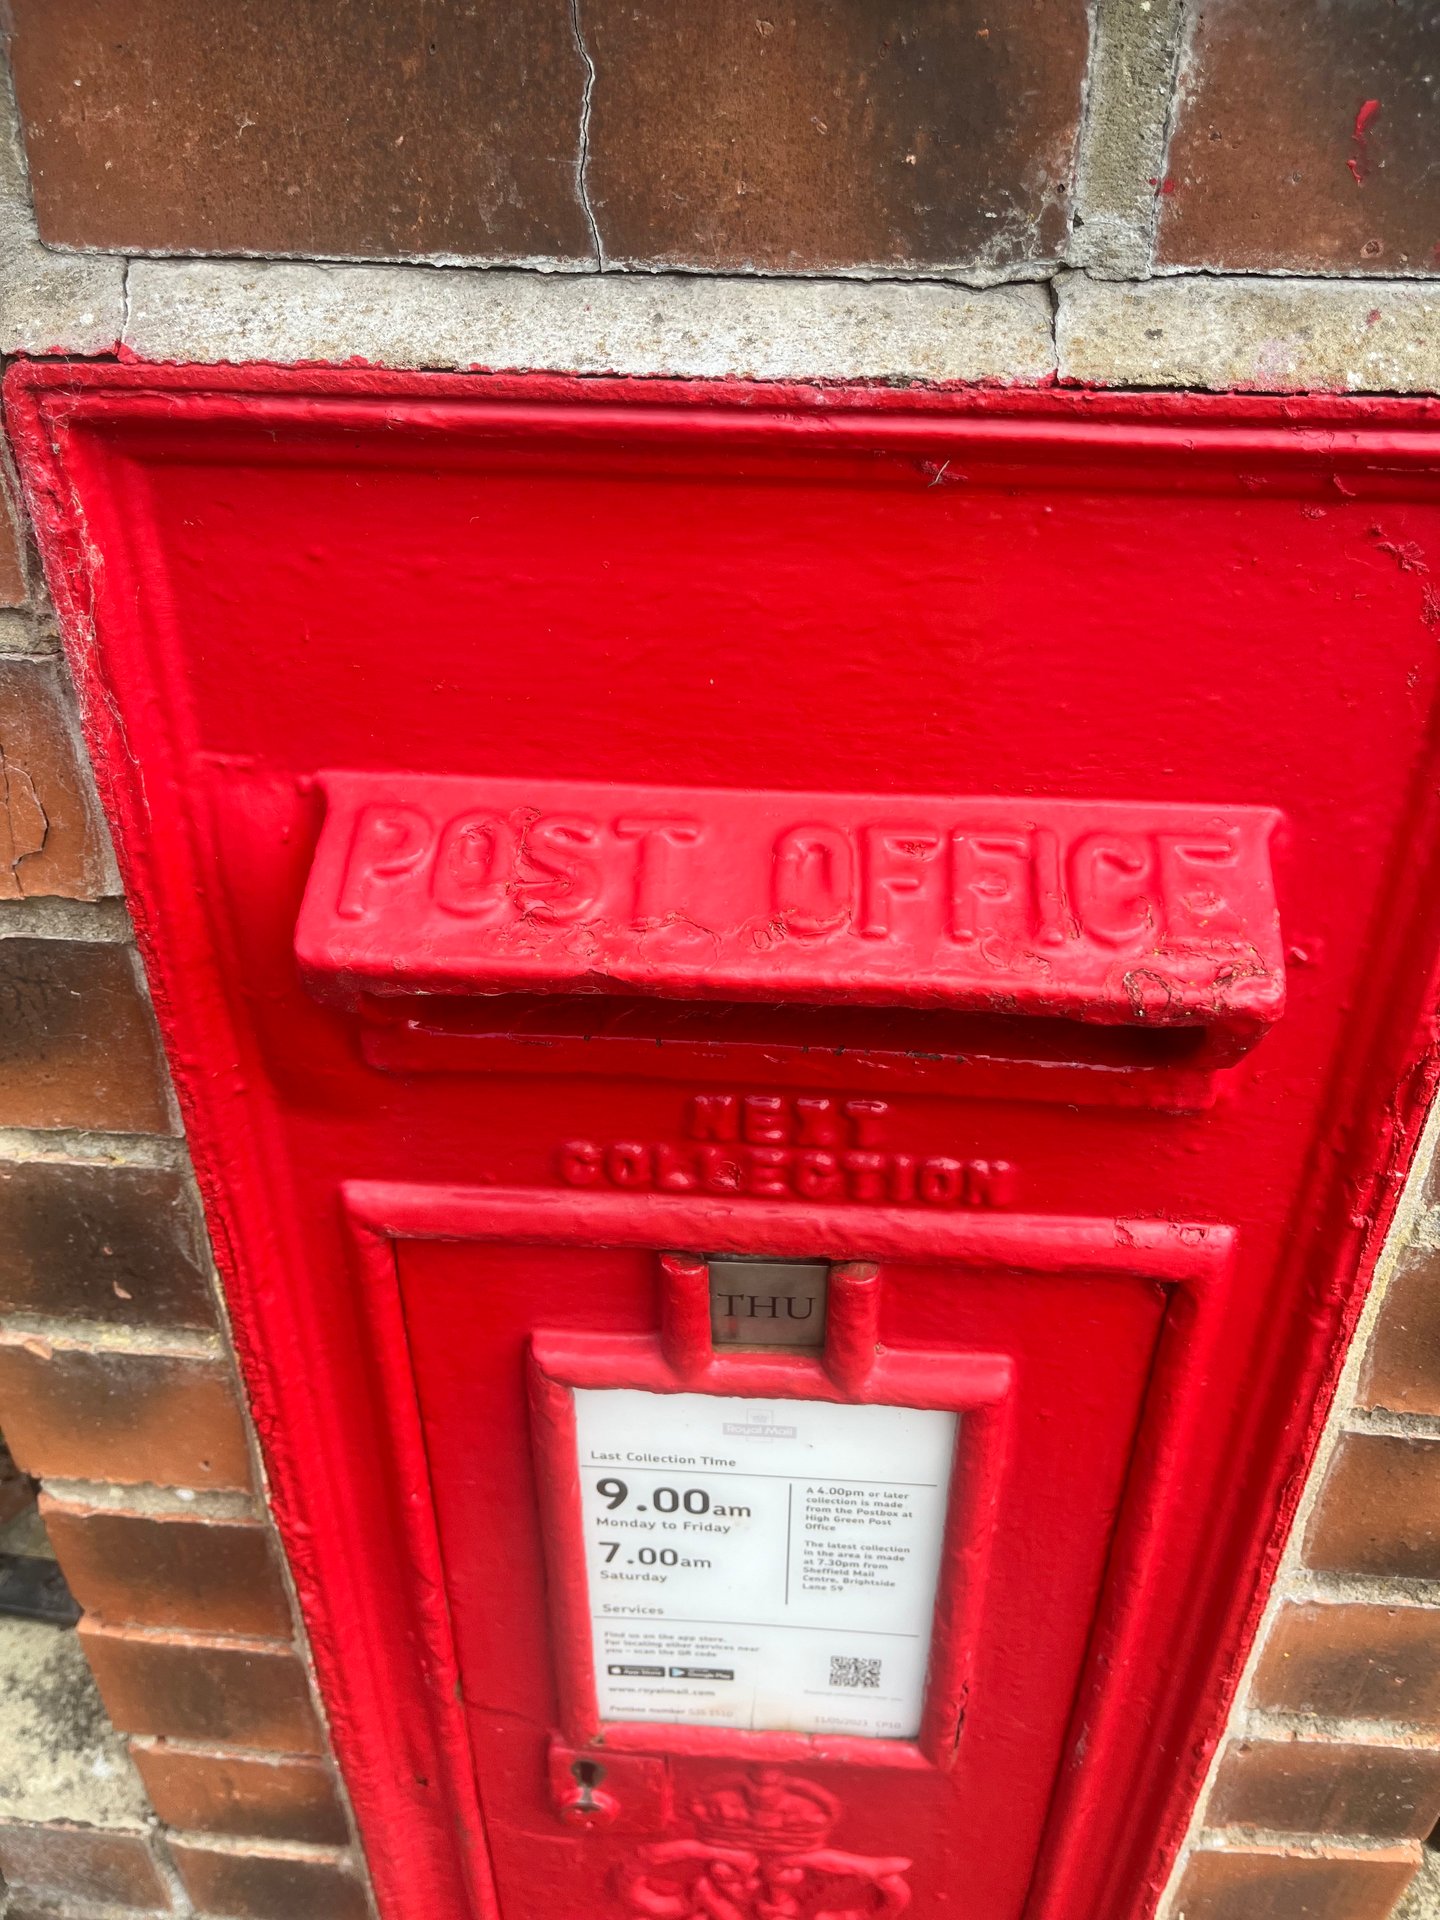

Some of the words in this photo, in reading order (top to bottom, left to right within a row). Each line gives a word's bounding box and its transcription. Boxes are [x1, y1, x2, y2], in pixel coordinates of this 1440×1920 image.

[335, 802, 702, 924] POST
[772, 820, 1248, 948] OFFICE
[693, 1095, 890, 1147] NEXT
[560, 1140, 1016, 1206] COLLECTION
[717, 1293, 816, 1320] THU
[726, 1424, 762, 1437] Royal
[765, 1426, 793, 1437] Mail
[590, 1450, 622, 1461] Last
[626, 1452, 696, 1465] Collection
[700, 1456, 737, 1467] Time
[596, 1477, 751, 1518] 9.00am
[806, 1487, 814, 1495] A
[817, 1486, 865, 1498] 4.00pm
[868, 1491, 881, 1499] or
[883, 1491, 910, 1500] later
[806, 1496, 857, 1506] collection
[861, 1499, 870, 1507] is
[873, 1500, 904, 1509] made
[805, 1505, 832, 1514] from
[835, 1507, 853, 1515] the
[856, 1508, 898, 1518] Postbox
[902, 1510, 913, 1518] at
[596, 1517, 656, 1530] Monday
[662, 1521, 677, 1530] to
[683, 1521, 731, 1534] Friday
[805, 1514, 830, 1523] High
[834, 1515, 865, 1525] Green
[868, 1517, 892, 1526] Post
[805, 1523, 836, 1532] Office
[804, 1540, 824, 1549] The
[827, 1541, 857, 1551] latest
[860, 1544, 911, 1554] collection
[598, 1541, 712, 1569] 7.00am
[804, 1549, 814, 1557] in
[817, 1550, 834, 1558] the
[837, 1552, 860, 1560] area
[864, 1552, 873, 1560] is
[876, 1554, 905, 1563] made
[803, 1558, 814, 1566] at
[817, 1558, 860, 1568] 7.30pm
[863, 1562, 888, 1570] from
[600, 1570, 668, 1584] Saturday
[803, 1567, 850, 1577] Sheffield
[853, 1569, 875, 1578] Mail
[802, 1583, 827, 1592] Lane
[842, 1577, 896, 1588] Brightside
[602, 1603, 664, 1616] Services
[607, 1686, 716, 1697] www.royalmail.com
